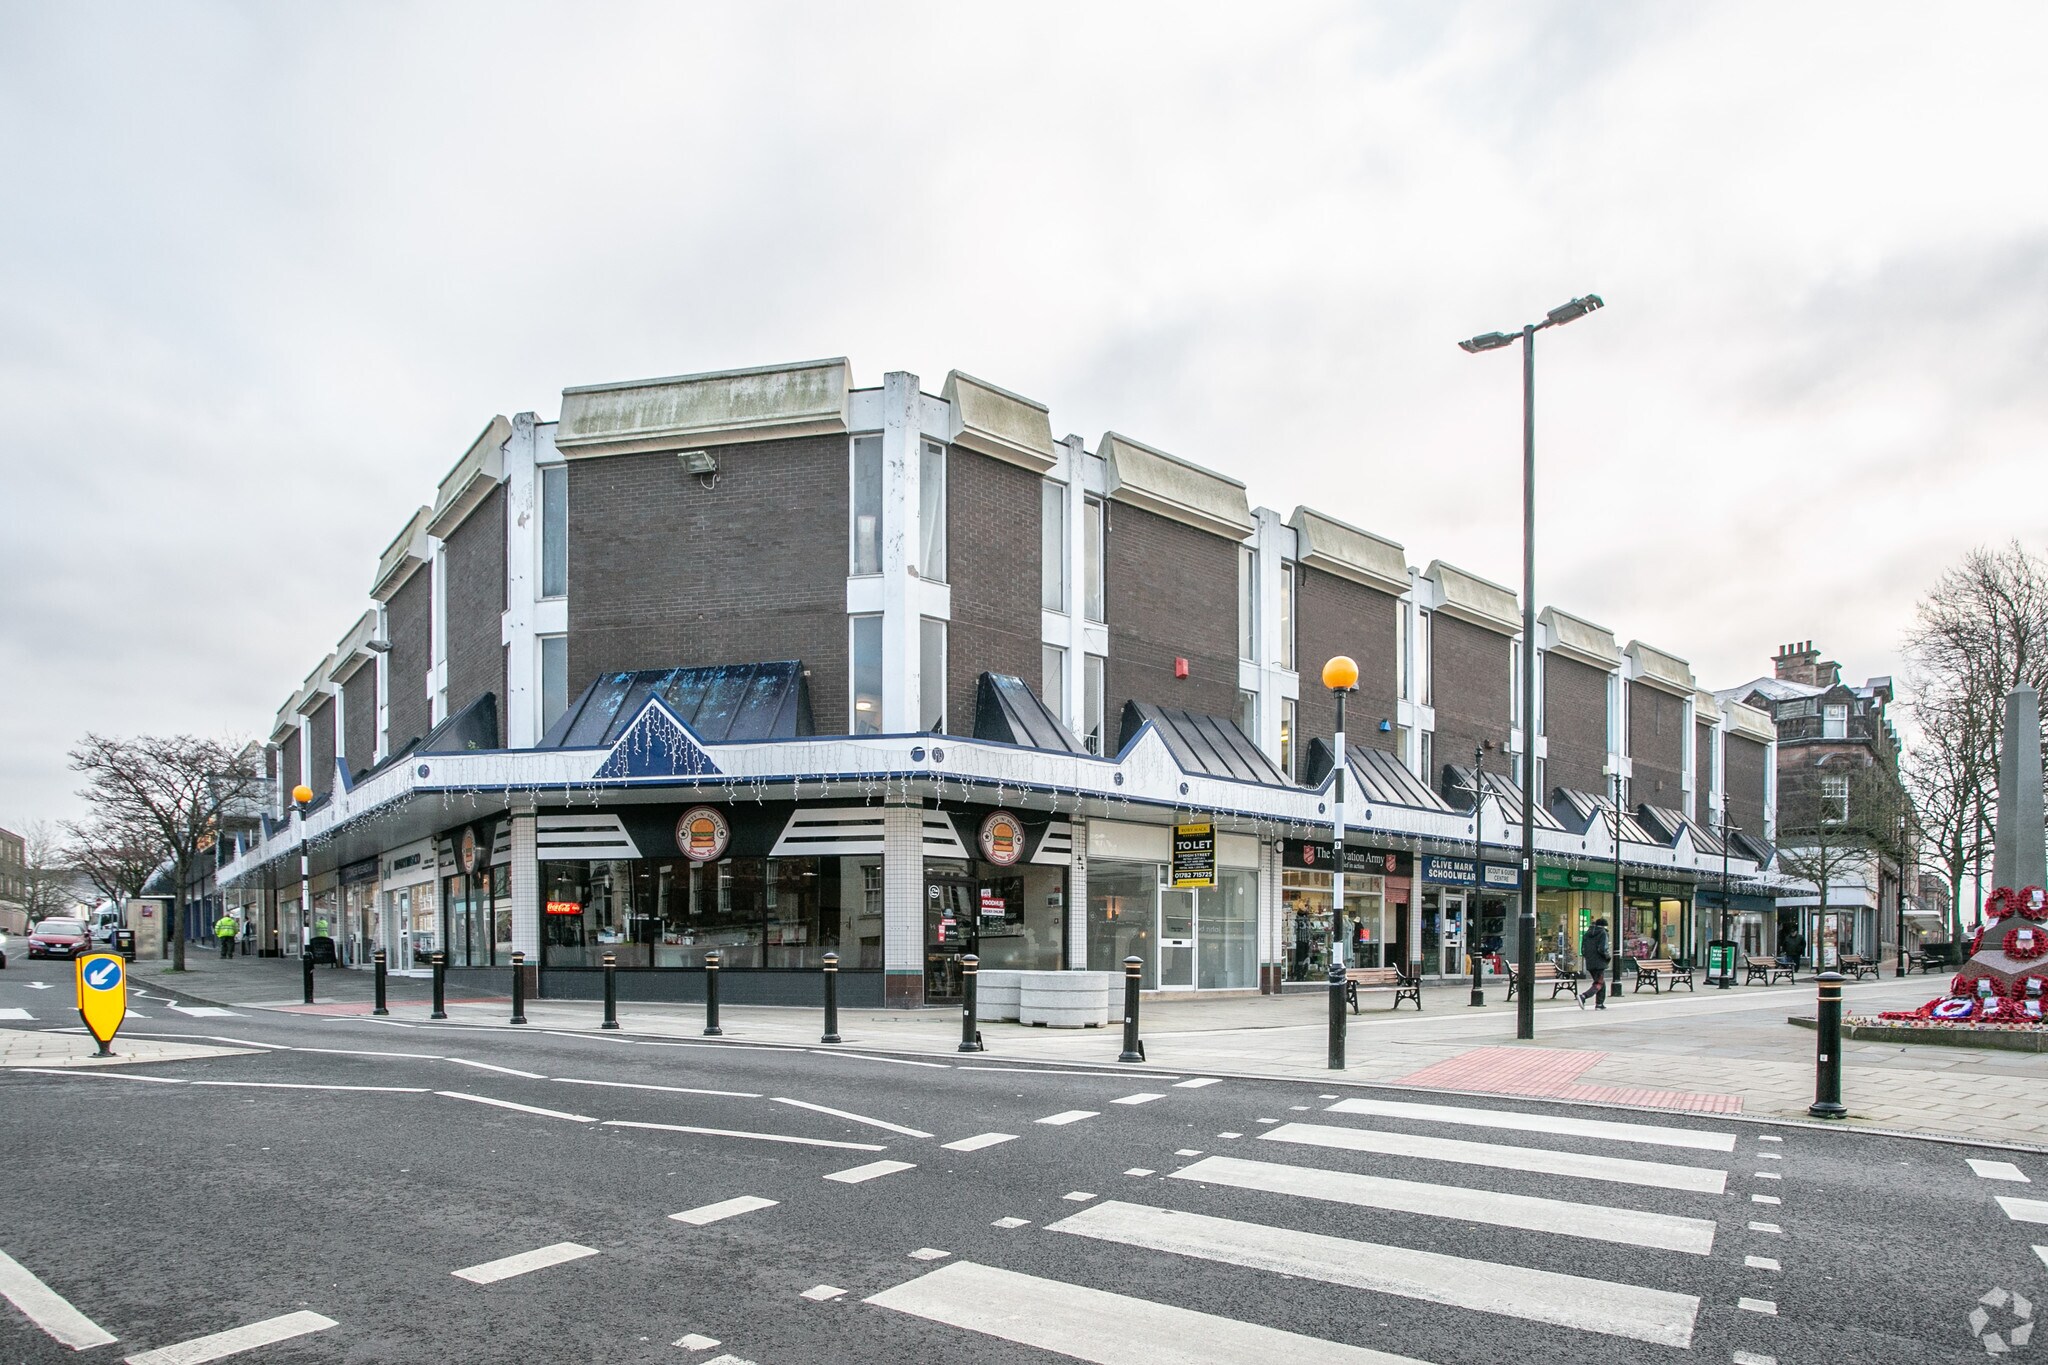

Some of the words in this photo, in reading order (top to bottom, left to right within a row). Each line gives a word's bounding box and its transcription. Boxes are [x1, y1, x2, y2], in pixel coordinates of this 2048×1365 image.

[685, 815, 698, 829] PATTY
[1176, 841, 1192, 850] TO
[1192, 840, 1213, 850] LET
[1316, 846, 1331, 859] The
[1332, 848, 1365, 862] Svation
[1365, 852, 1385, 867] Army
[1431, 860, 1453, 870] CLIVE
[1454, 862, 1474, 872] MARK
[1428, 869, 1476, 881] SCHOOLWEAR
